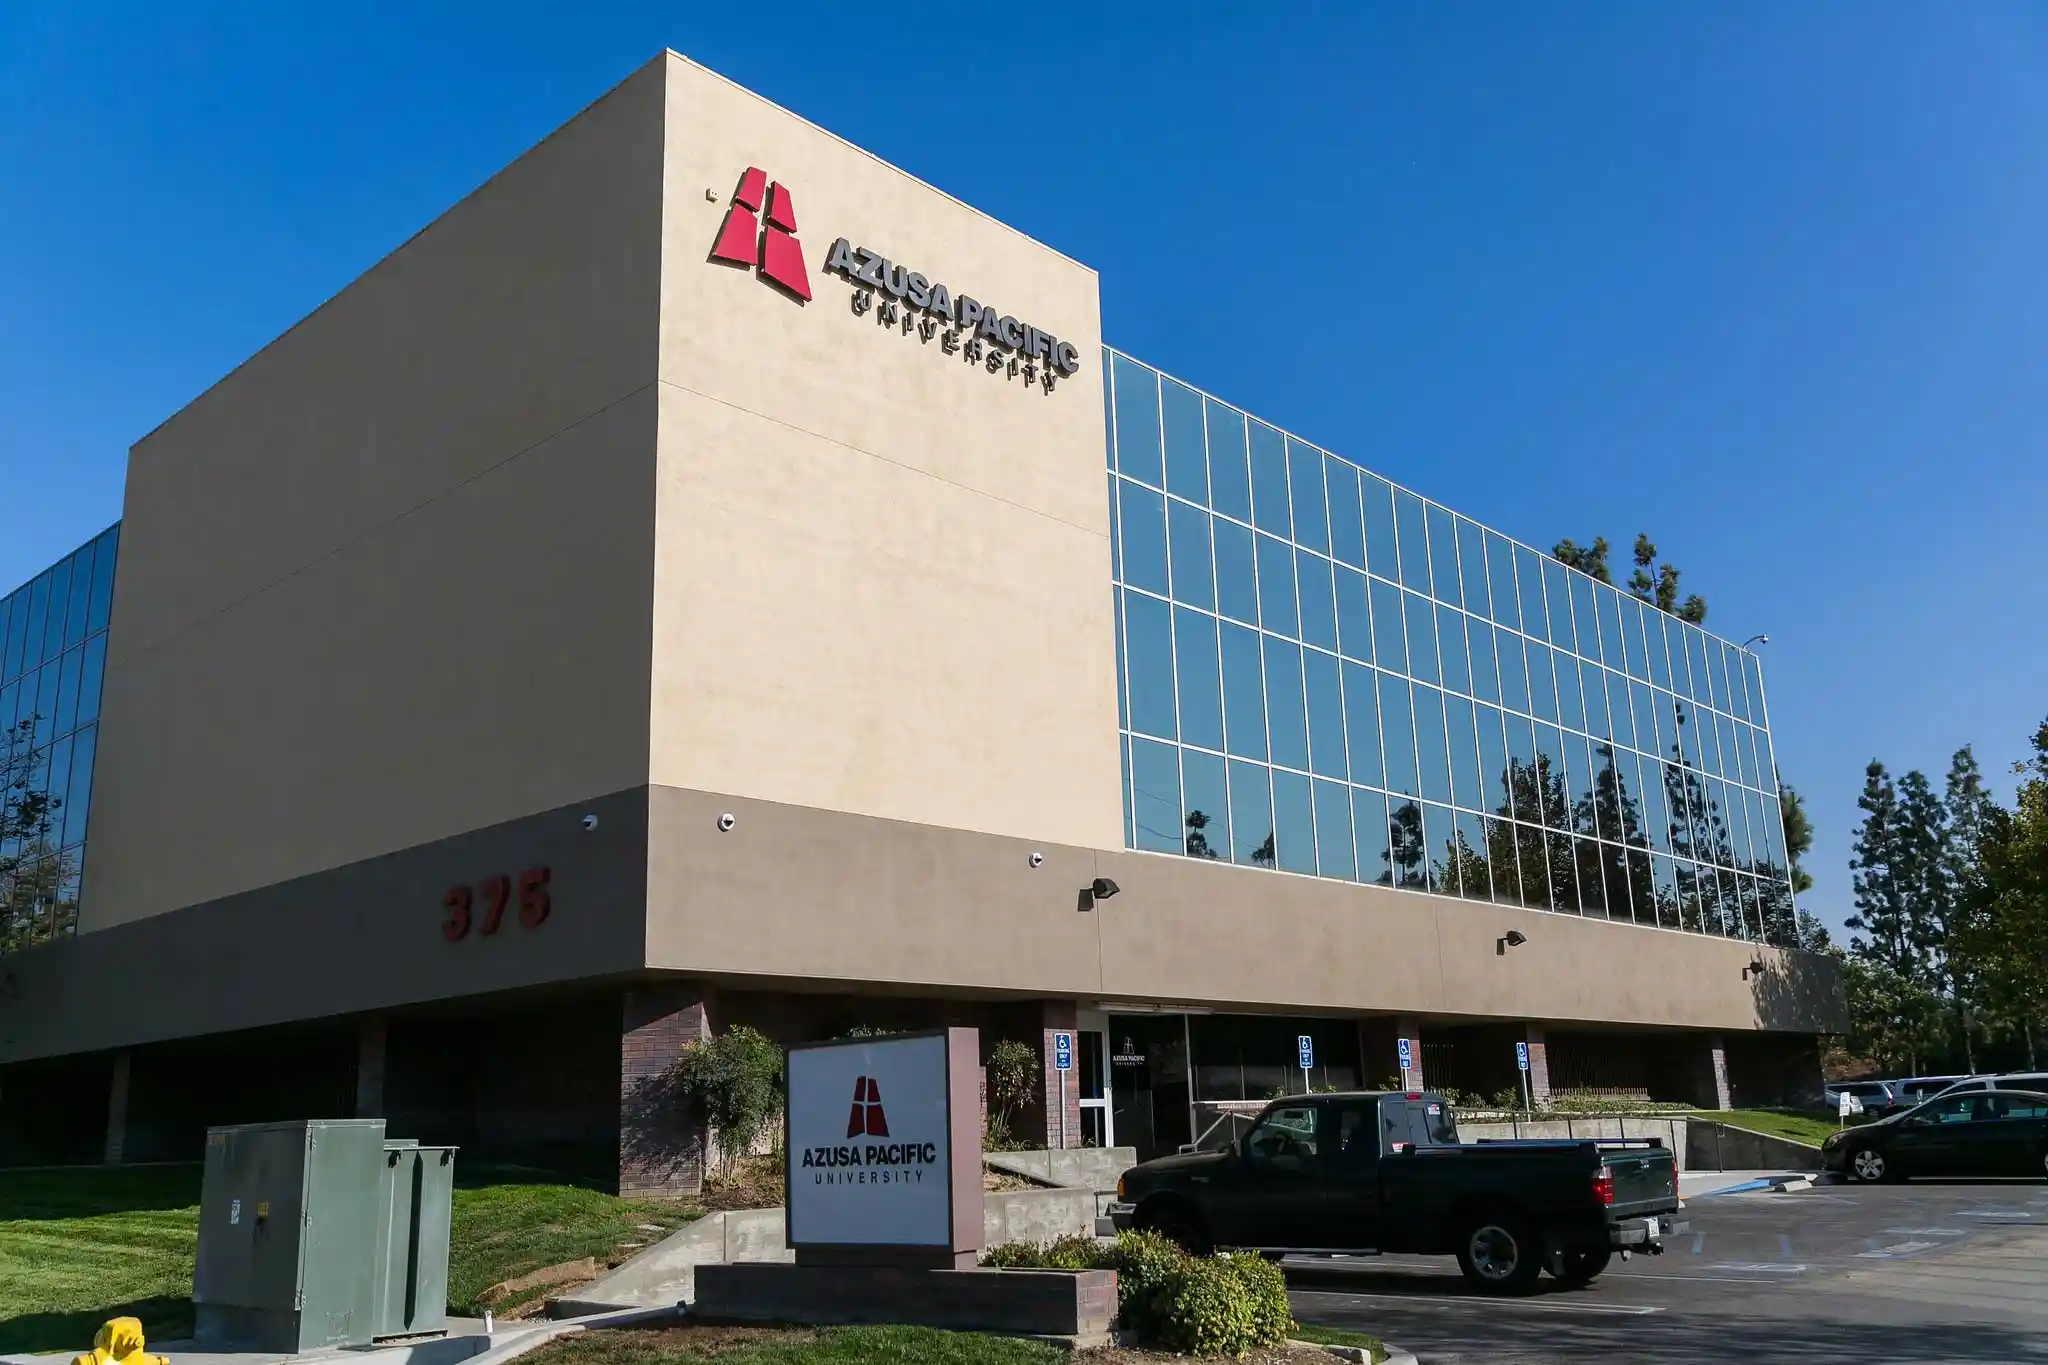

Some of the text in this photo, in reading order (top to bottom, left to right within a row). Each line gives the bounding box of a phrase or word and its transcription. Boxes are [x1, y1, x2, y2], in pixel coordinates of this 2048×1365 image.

[823, 237, 1079, 378] AZUSA PACIFIC
[852, 289, 1058, 396] UNIVERSITY
[442, 866, 551, 941] 375
[802, 1143, 936, 1167] AZUSA PACIFIC
[815, 1170, 923, 1185] UNIVERSITY
